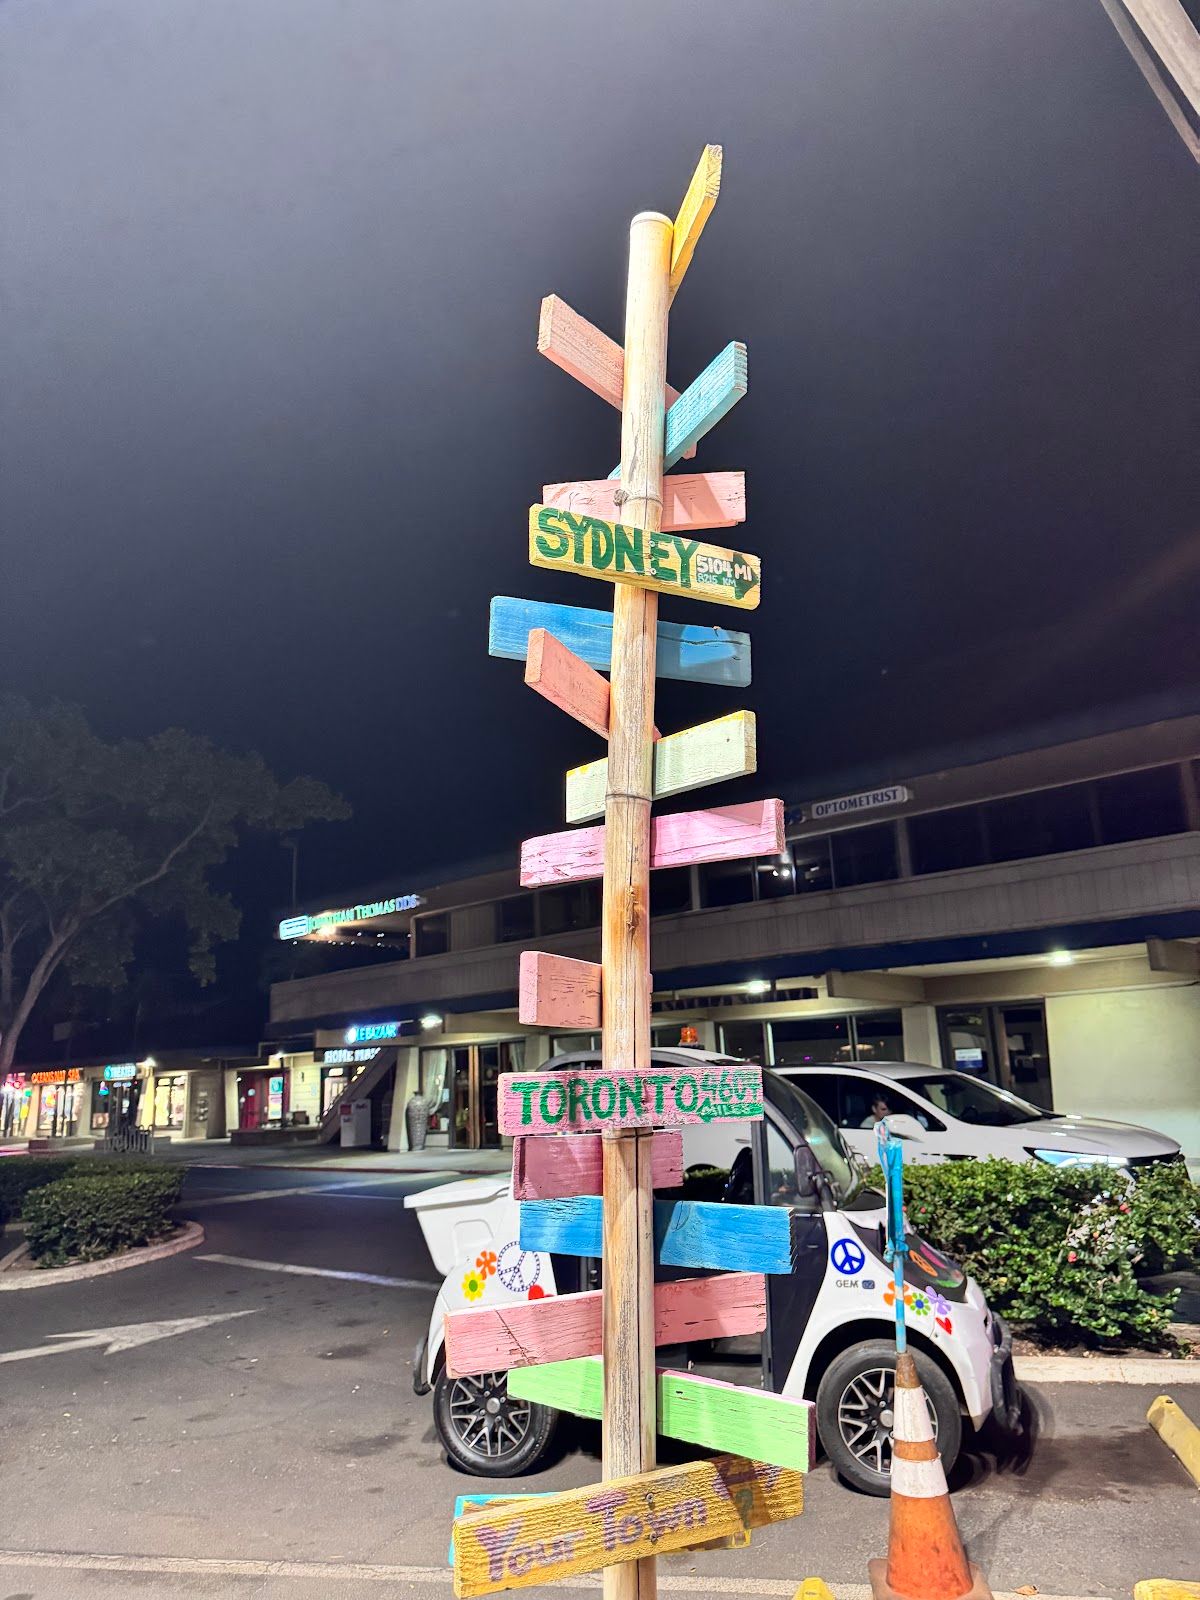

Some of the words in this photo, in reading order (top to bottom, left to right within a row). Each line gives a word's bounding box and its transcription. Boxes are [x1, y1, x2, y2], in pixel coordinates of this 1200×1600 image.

[535, 507, 700, 589] SYDNEY
[697, 554, 733, 578] 5104
[734, 563, 753, 582] MI
[697, 573, 718, 585] 8215
[722, 577, 737, 588] KM
[815, 789, 898, 816] OPTOMETRIST
[354, 899, 396, 920] THOMAS
[395, 894, 417, 912] DDS
[365, 1024, 397, 1040] BAZAAR
[324, 1049, 354, 1064] HOME
[511, 1074, 699, 1125] TORONTO
[835, 1279, 859, 1288] GEM
[474, 1517, 586, 1582] Your
[585, 1490, 708, 1551] Town
